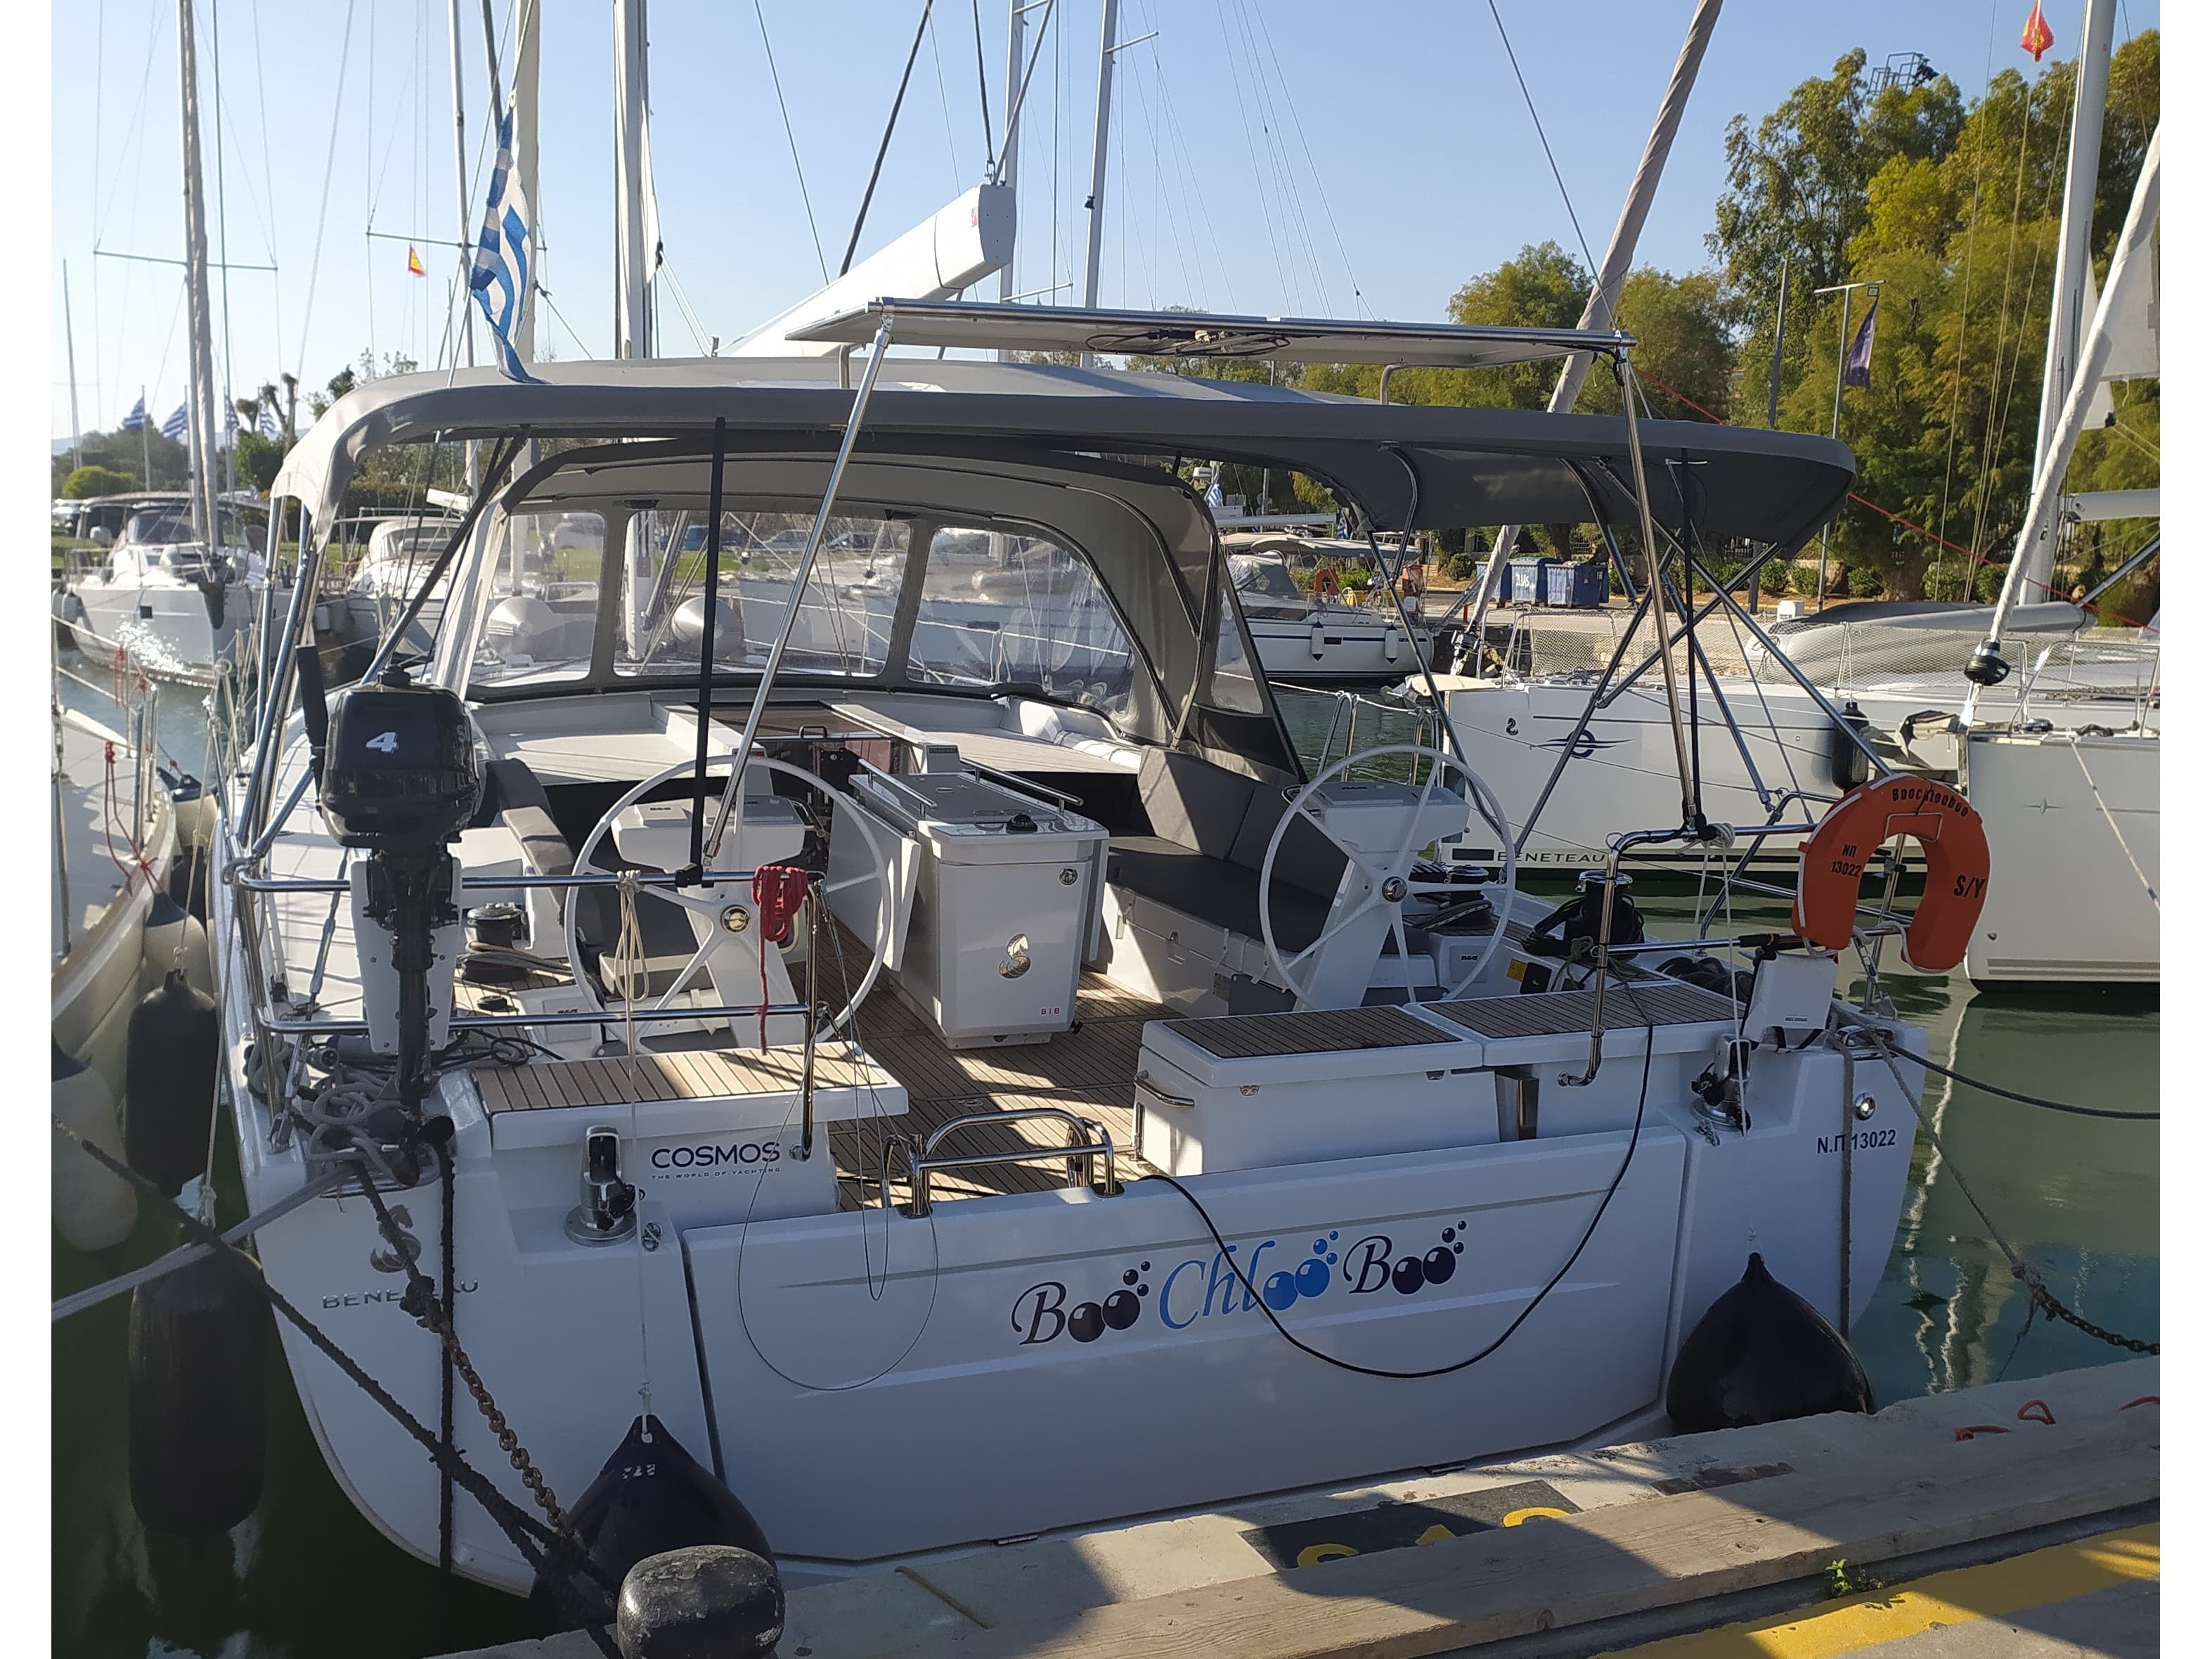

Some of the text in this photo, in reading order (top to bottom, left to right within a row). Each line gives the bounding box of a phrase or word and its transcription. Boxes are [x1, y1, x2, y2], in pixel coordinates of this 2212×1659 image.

[365, 731, 399, 754] 4
[1832, 860, 1861, 878] 13022
[1953, 874, 1986, 898] S/Y
[1851, 1129, 1896, 1151] 13022
[651, 1141, 780, 1169] COSMOS
[732, 1167, 781, 1175] YACHTING
[322, 1279, 479, 1309] BENEU
[1011, 1281, 1141, 1346] Boo
[1343, 1234, 1457, 1296] Boo
